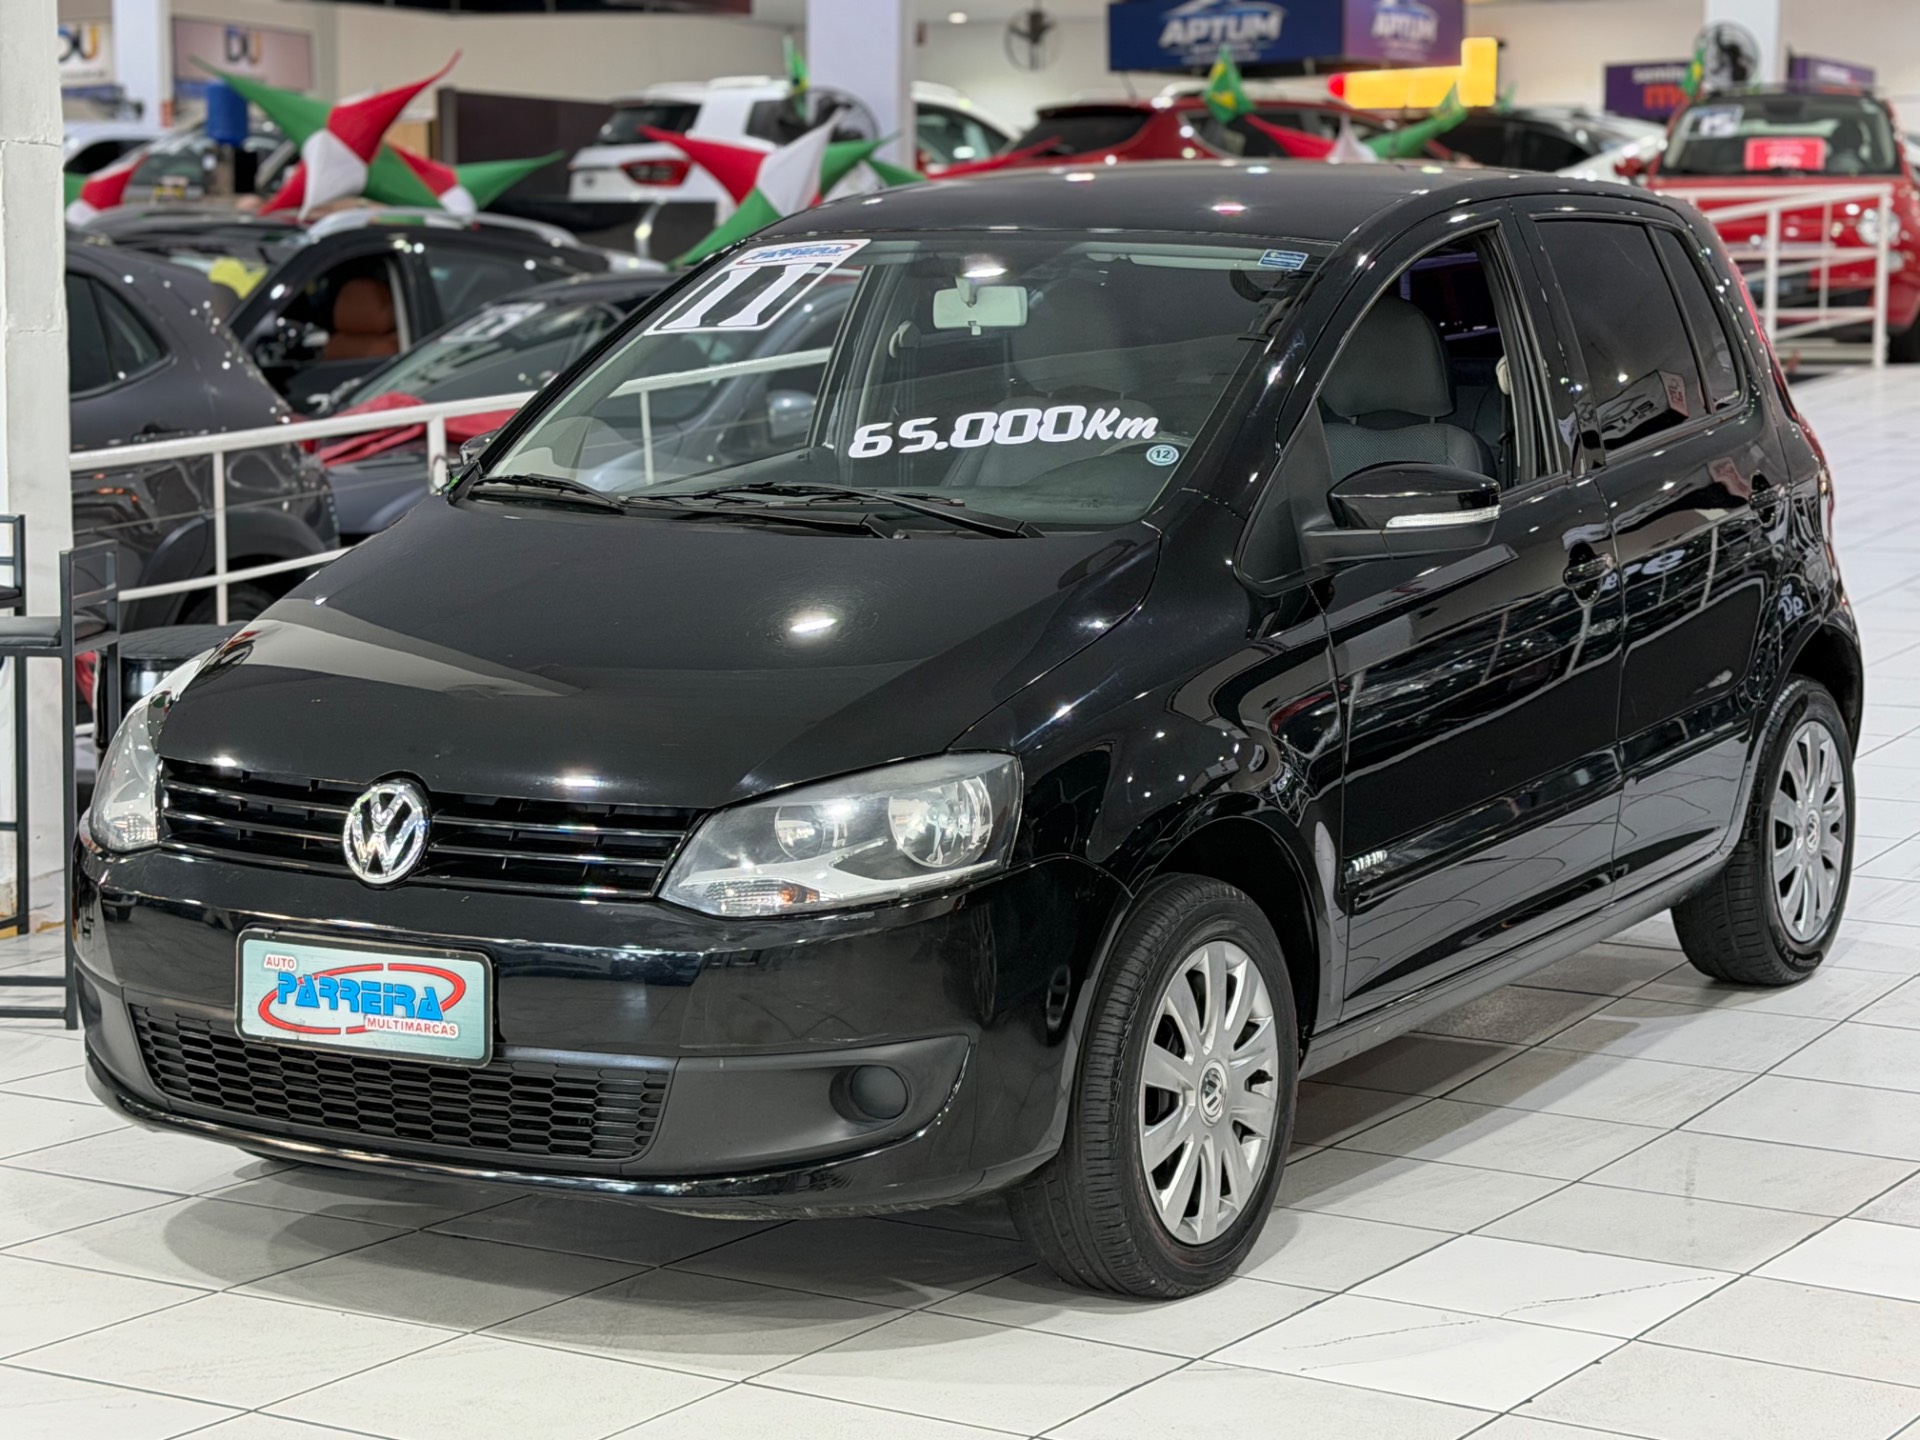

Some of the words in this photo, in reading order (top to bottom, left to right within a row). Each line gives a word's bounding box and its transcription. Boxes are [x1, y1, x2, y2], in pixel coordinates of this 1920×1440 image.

[1158, 13, 1284, 48] APTUM
[1155, 449, 1171, 459] 12
[265, 956, 295, 969] AUTO
[277, 971, 444, 1021] PARREIRA
[366, 1017, 457, 1037] MULTIMARCAS
